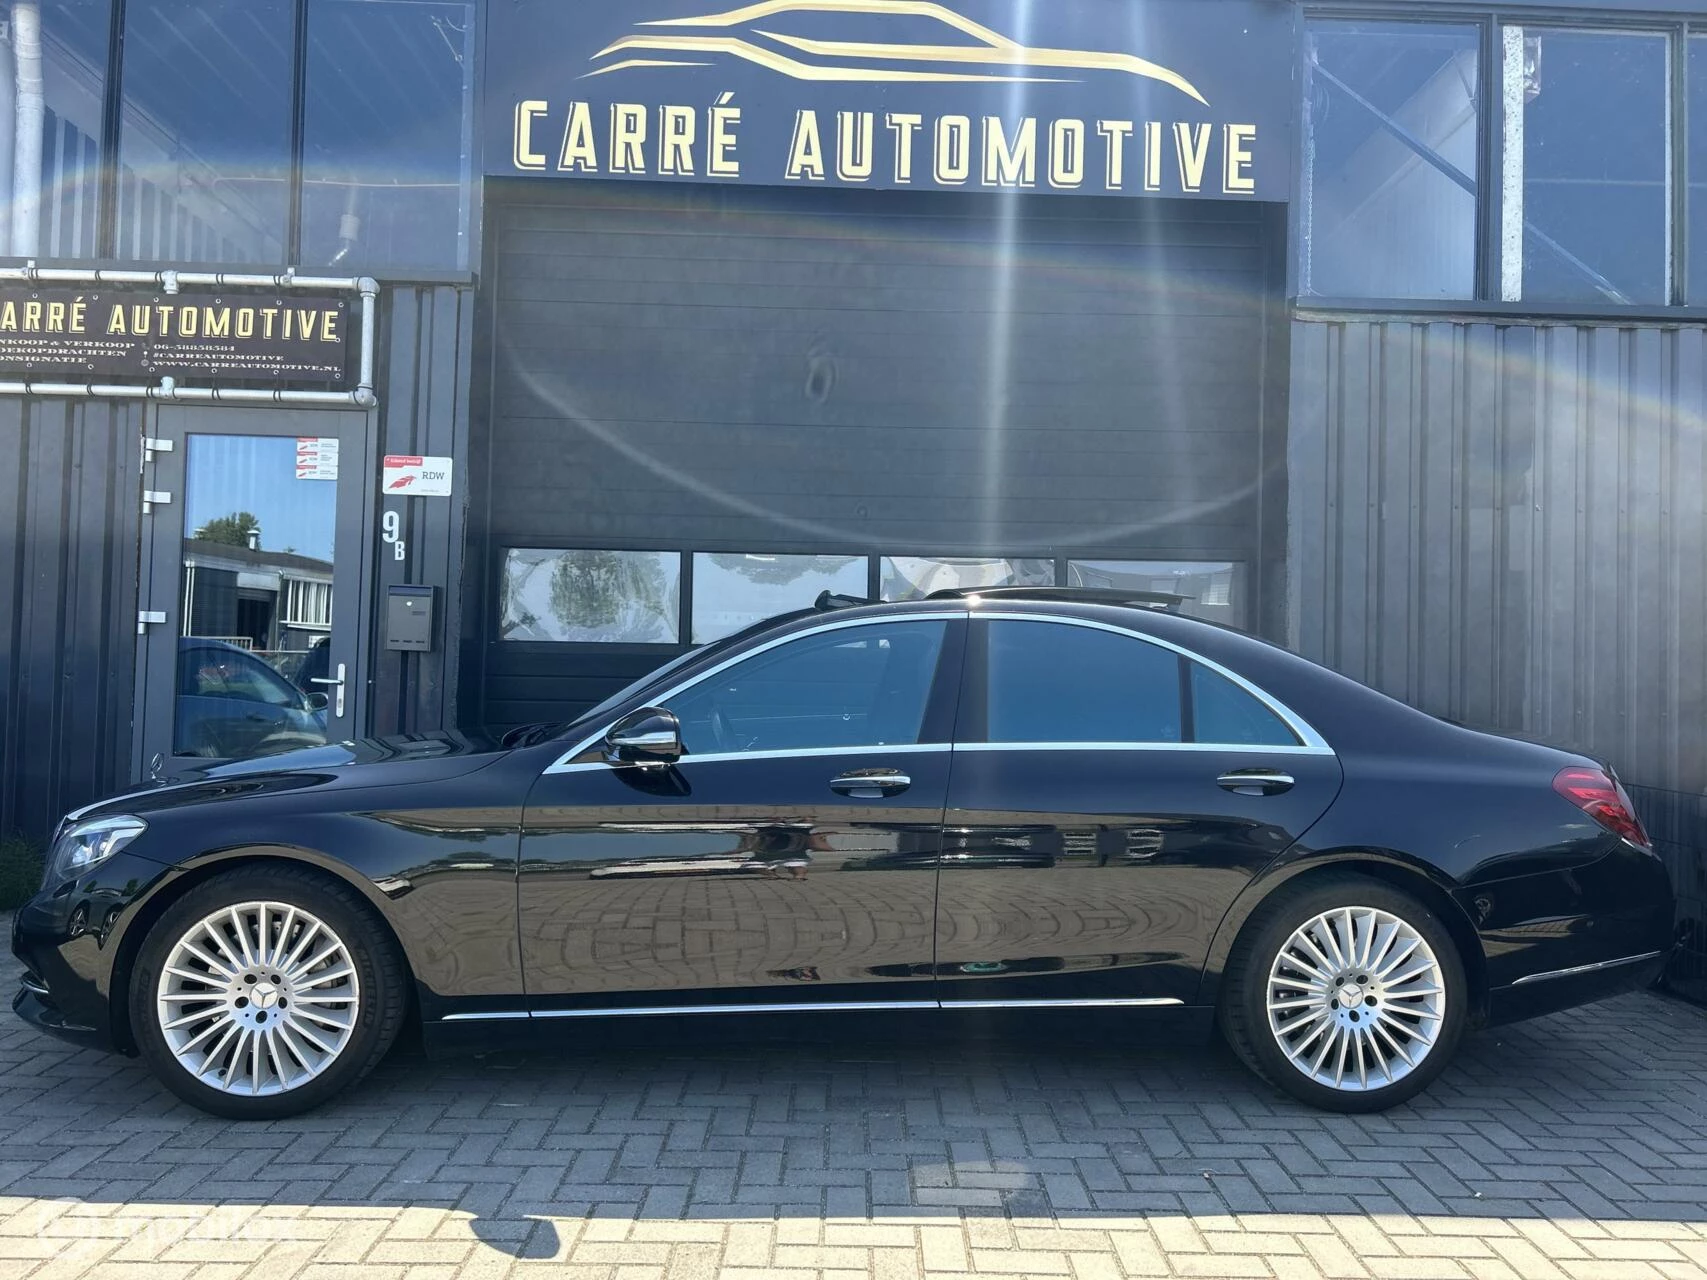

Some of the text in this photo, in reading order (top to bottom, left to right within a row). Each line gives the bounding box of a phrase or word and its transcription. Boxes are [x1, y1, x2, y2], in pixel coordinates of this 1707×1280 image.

[513, 92, 1257, 195] CARRÉ AUTOMOTIVE
[0, 296, 339, 342] ARRÉ AUTOMOTIVE
[63, 340, 135, 349] VERKOOP
[153, 352, 284, 361] #CARREAUTOMOTIVE
[153, 360, 342, 373] WWW.CARREAUTOMOTIVE.NL
[422, 471, 445, 480] RDW
[382, 510, 405, 561] 9 B
